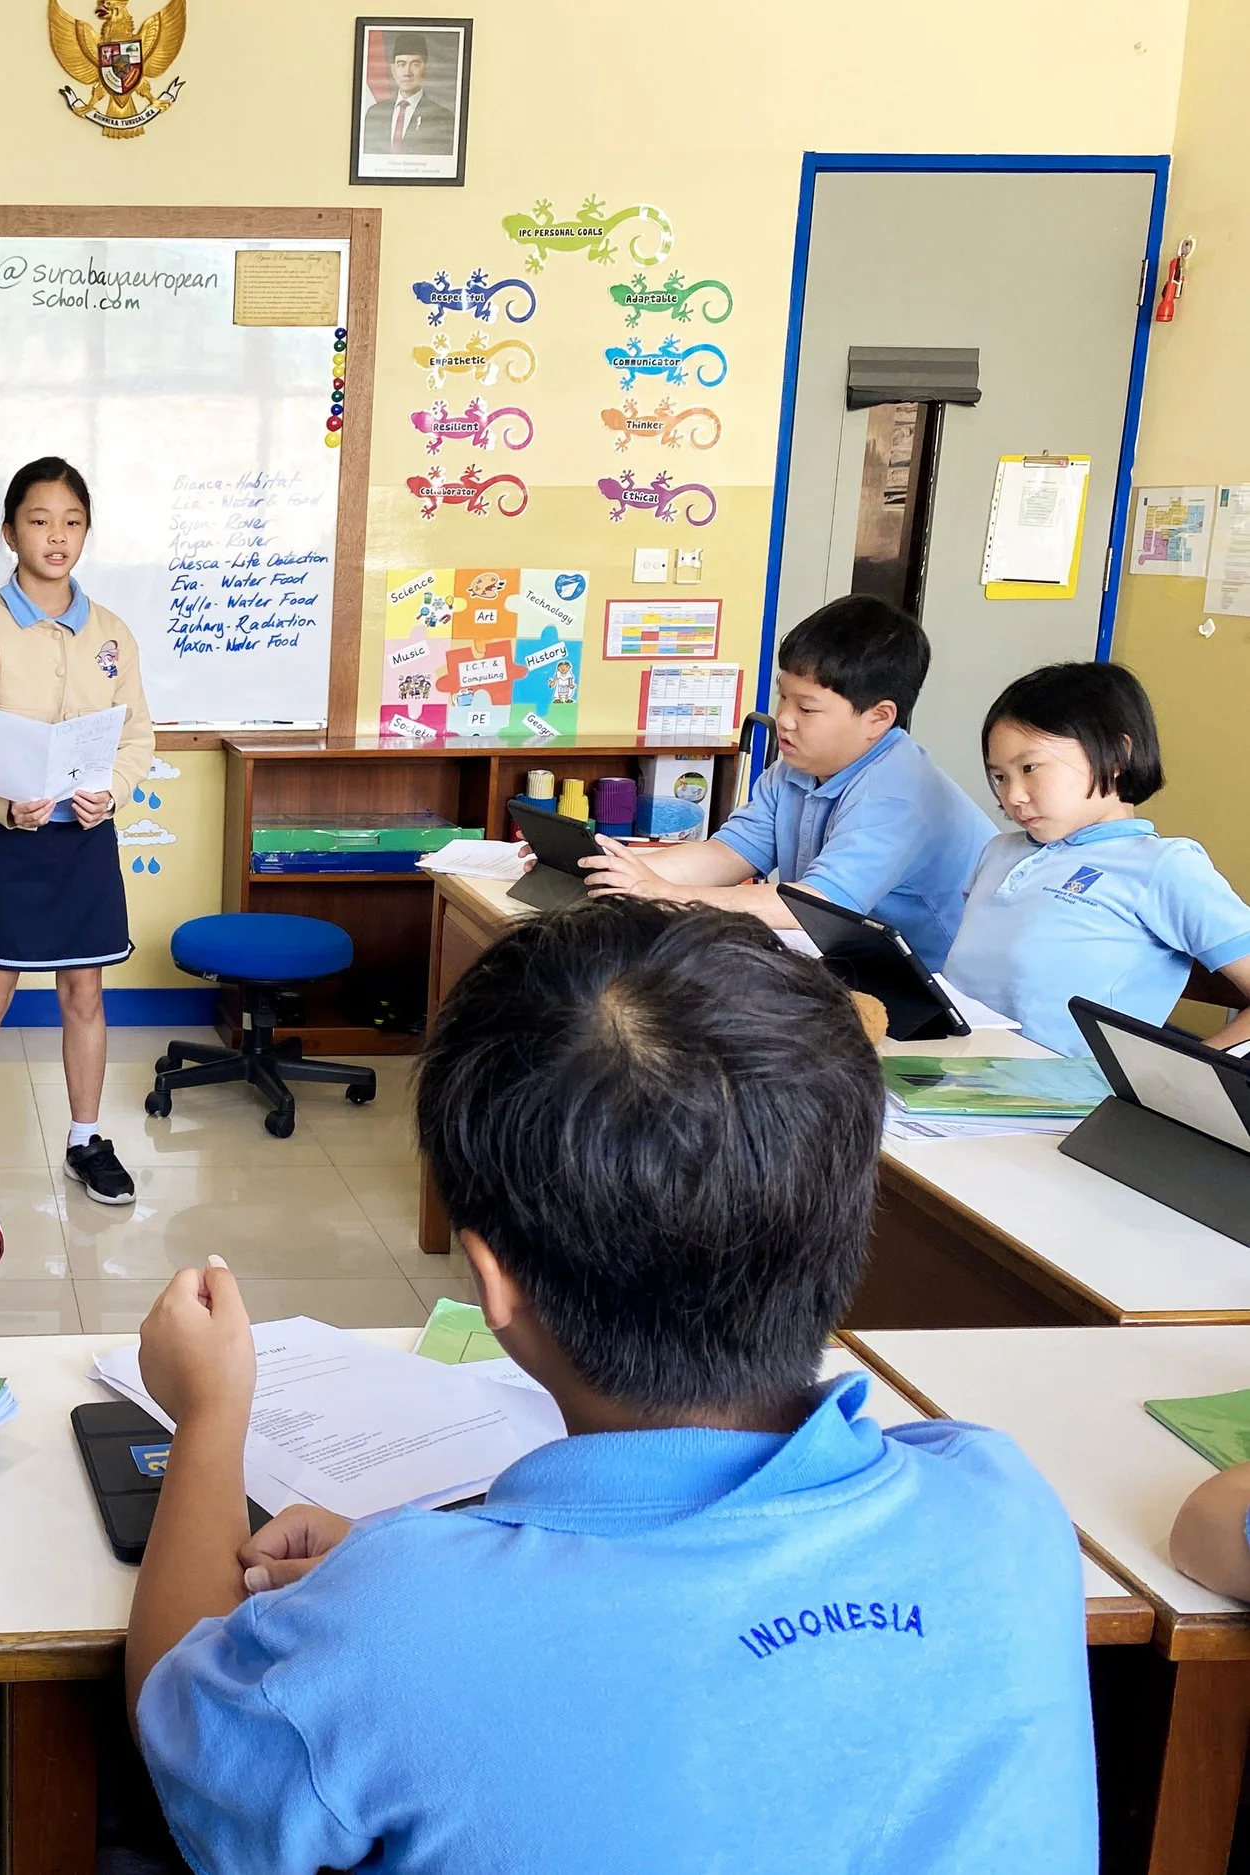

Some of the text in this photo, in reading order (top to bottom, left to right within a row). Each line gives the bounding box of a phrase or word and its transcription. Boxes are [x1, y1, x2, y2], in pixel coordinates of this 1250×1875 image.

[519, 228, 603, 238] IPC PERSONAL GOALS
[431, 293, 485, 303] Respecful
[625, 294, 678, 304] Adaptable
[429, 356, 486, 366] Empathetic
[613, 357, 681, 366] Communicator
[433, 422, 479, 432] Resilient
[626, 420, 664, 430] Thinker
[236, 472, 303, 490] Habitat
[623, 491, 658, 503] Ethical
[225, 513, 275, 531] Rover
[225, 532, 277, 549] Rover
[168, 556, 220, 571] Chesca
[267, 551, 329, 568] Detection
[221, 571, 268, 588] Water
[270, 571, 309, 586] Food
[390, 576, 435, 604] Science
[227, 591, 273, 609] Water
[278, 592, 319, 608] Food
[525, 590, 574, 626] Technology
[235, 612, 317, 634] Radiation
[477, 611, 495, 622] Art
[267, 632, 300, 648] Food
[392, 647, 426, 665] Music
[526, 646, 567, 667] History
[462, 672, 504, 684] Computing
[471, 714, 486, 724] PE
[123, 829, 163, 838] December
[1042, 886, 1098, 908] Surabaya European
[1054, 894, 1077, 905] School
[738, 1601, 925, 1659] INDONESIA
